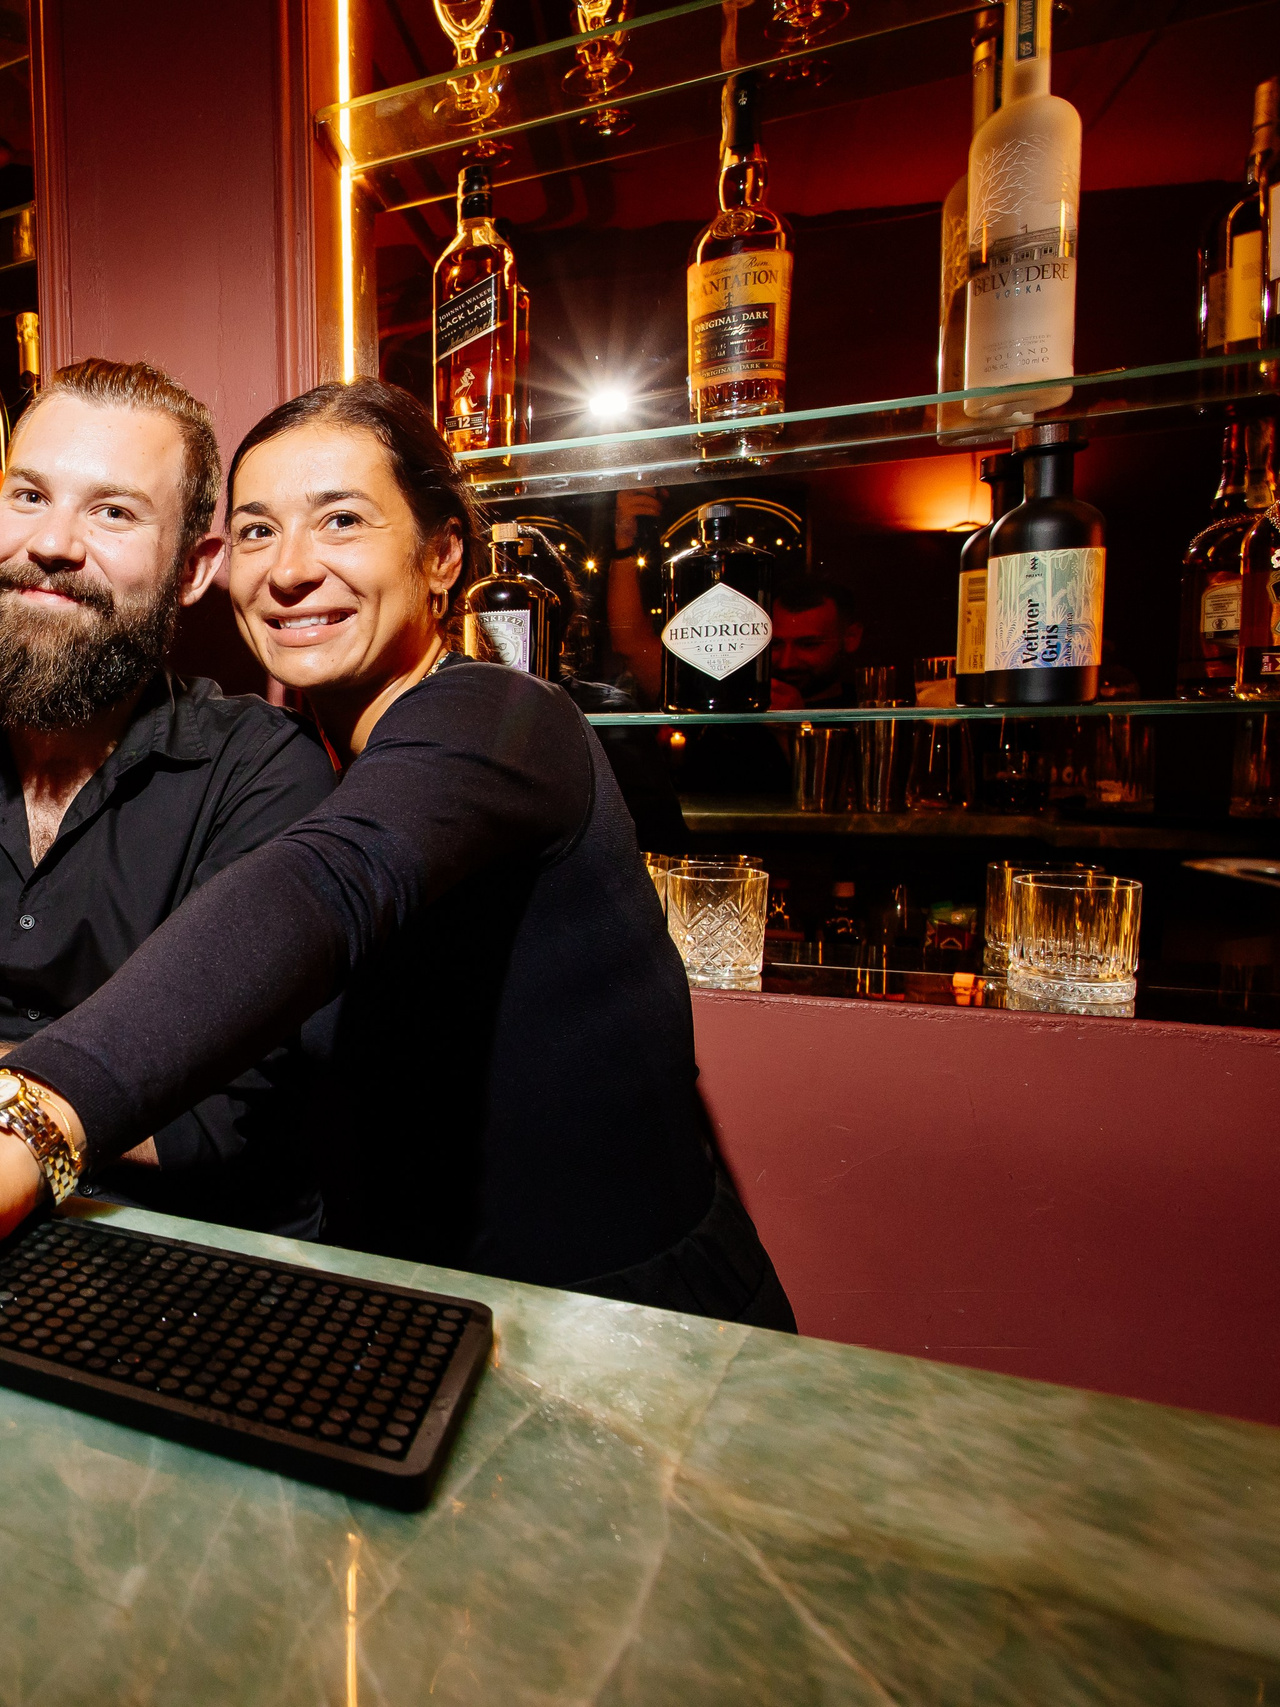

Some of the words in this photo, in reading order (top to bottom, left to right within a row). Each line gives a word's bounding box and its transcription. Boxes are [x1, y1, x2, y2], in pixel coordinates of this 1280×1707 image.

[973, 262, 1070, 297] BELVEDERE
[439, 303, 466, 323] JOHNNIE
[465, 287, 492, 305] WALKER
[438, 312, 466, 333] LACK
[694, 314, 739, 333] ORIGINAL
[741, 311, 769, 321] DARK
[986, 346, 1049, 364] POLAND
[740, 363, 761, 371] DARK
[457, 416, 470, 429] 12
[510, 617, 523, 626] 47
[669, 622, 769, 641] HENDRICK'S
[1022, 599, 1040, 664] Vetiver
[704, 642, 738, 653] GIN
[1041, 624, 1059, 663] Gris
